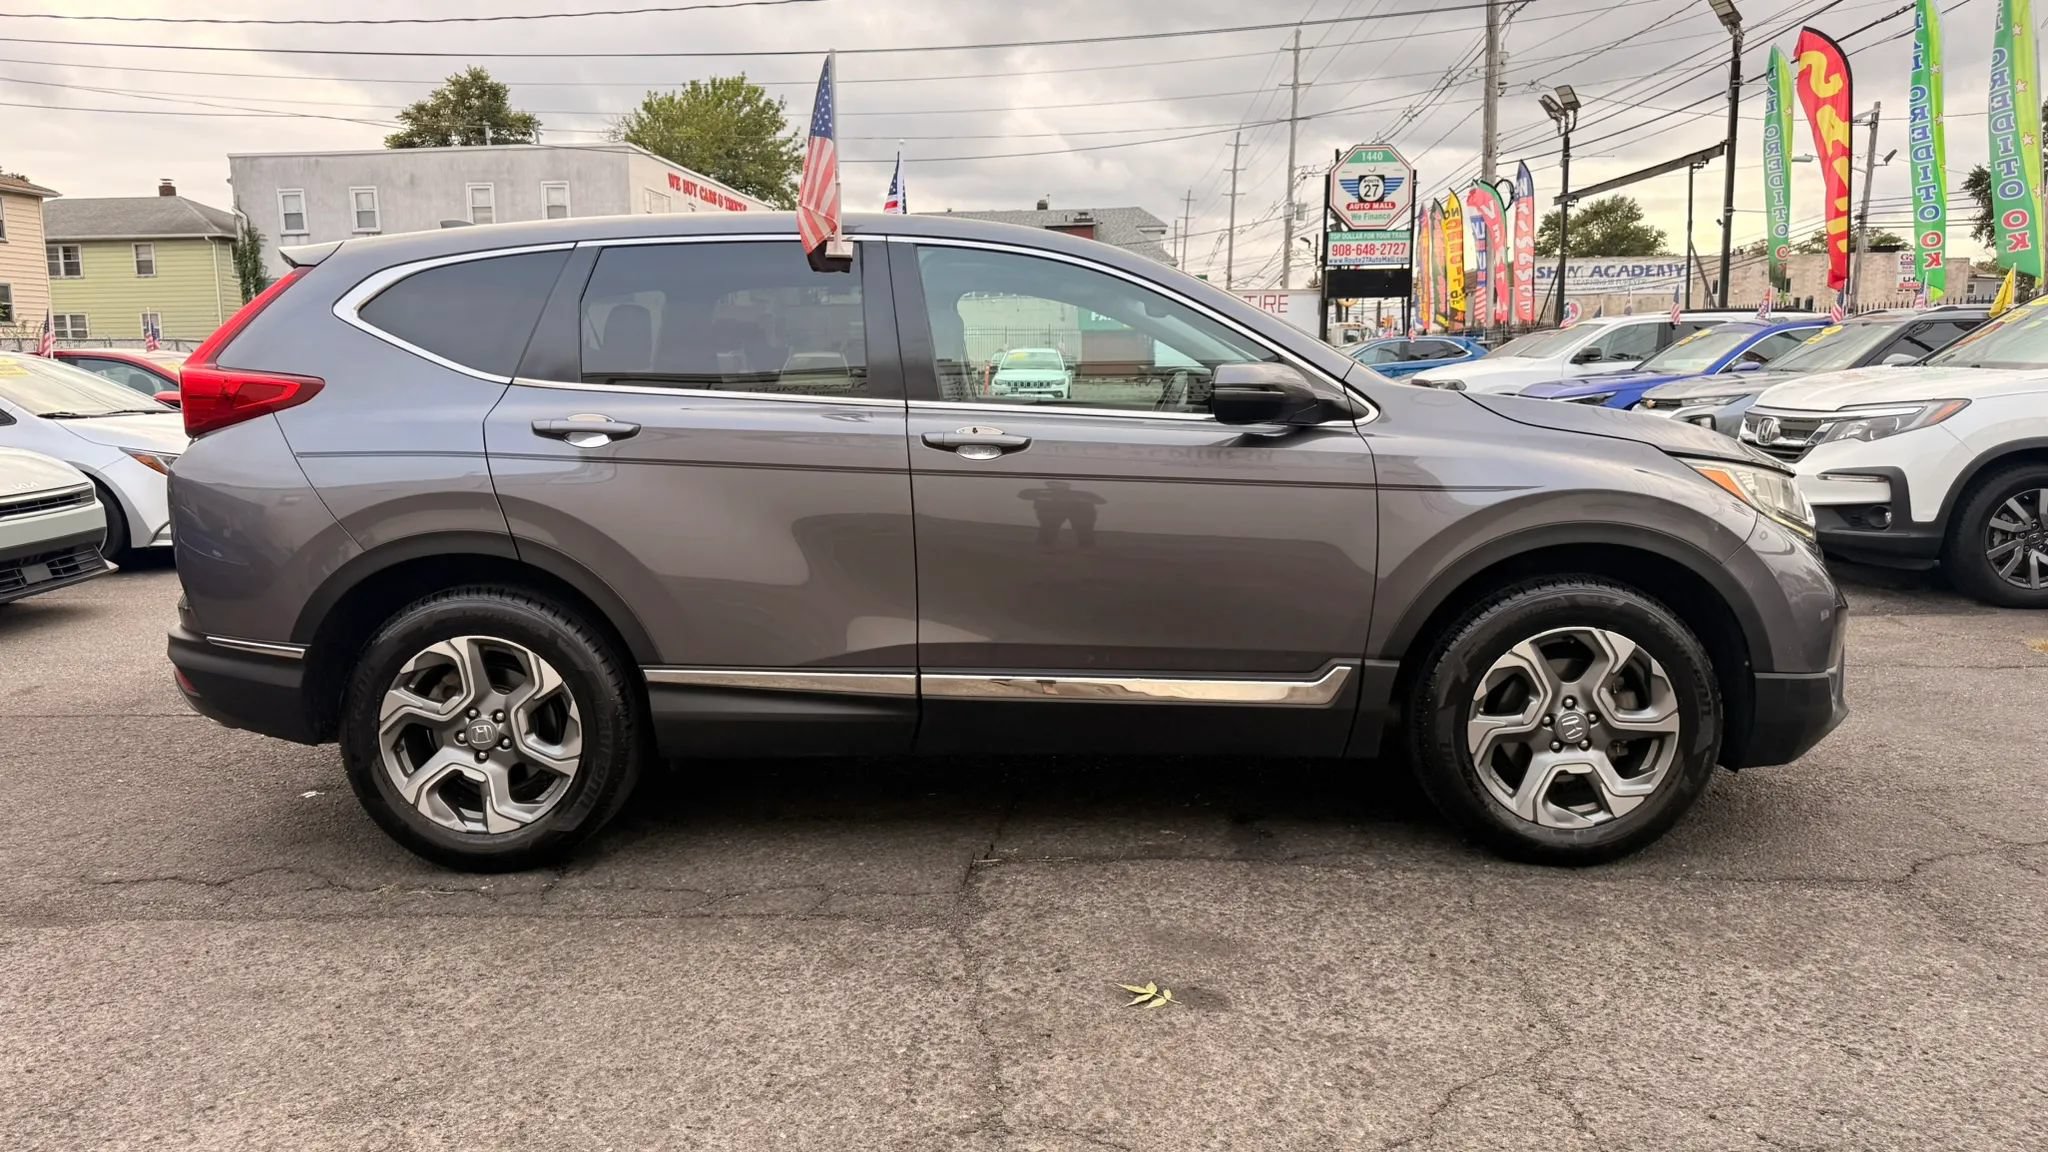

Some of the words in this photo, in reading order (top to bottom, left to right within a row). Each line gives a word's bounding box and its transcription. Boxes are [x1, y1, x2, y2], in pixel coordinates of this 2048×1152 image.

[1362, 152, 1383, 161] 1440
[668, 172, 681, 191] WE
[683, 179, 697, 197] BUY
[699, 186, 717, 205] CARS
[1363, 184, 1379, 198] 27
[1332, 243, 1406, 256] 908-648-2727
[1589, 265, 1685, 277] ACADEMY
[1243, 295, 1288, 313] TIRE
